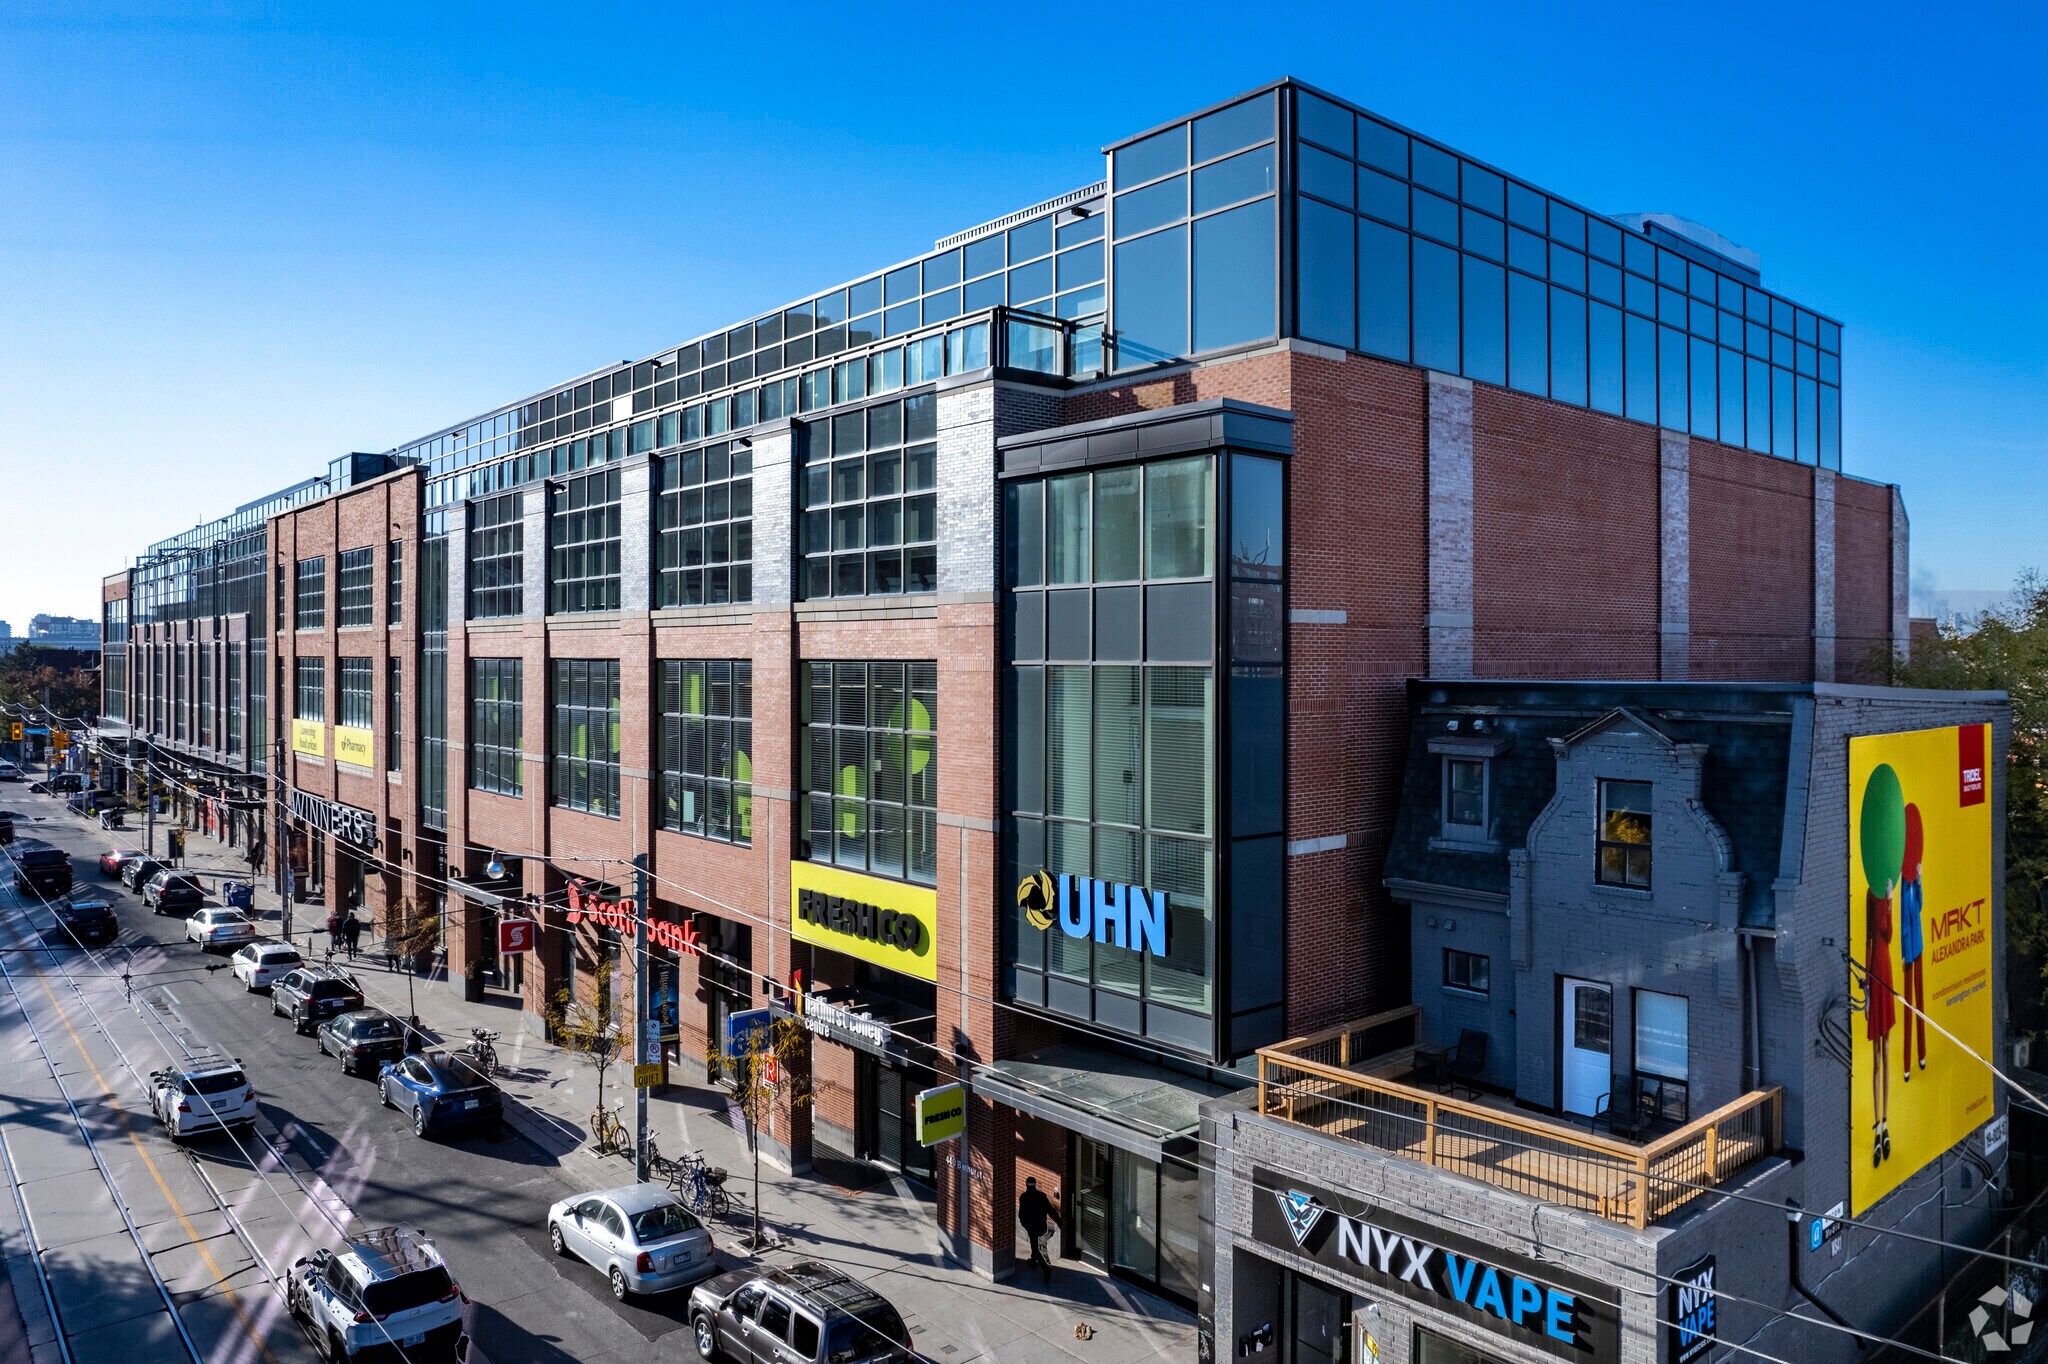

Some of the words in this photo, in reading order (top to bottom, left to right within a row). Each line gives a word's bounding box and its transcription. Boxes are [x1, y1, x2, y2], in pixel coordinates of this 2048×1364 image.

[346, 739, 366, 755] Pharmacy
[291, 790, 365, 844] WINNERS
[1059, 873, 1168, 957] UHN
[1931, 898, 1985, 944] MRKT
[1931, 936, 1970, 965] ALEXANDRA
[1970, 928, 1986, 949] PARK
[805, 1018, 830, 1037] centre
[638, 1072, 660, 1086] QUIET
[1338, 1215, 1435, 1292] NYX
[1446, 1253, 1577, 1345] VAPE
[1679, 1266, 1714, 1319] NYX
[1679, 1299, 1715, 1348] VAPE
